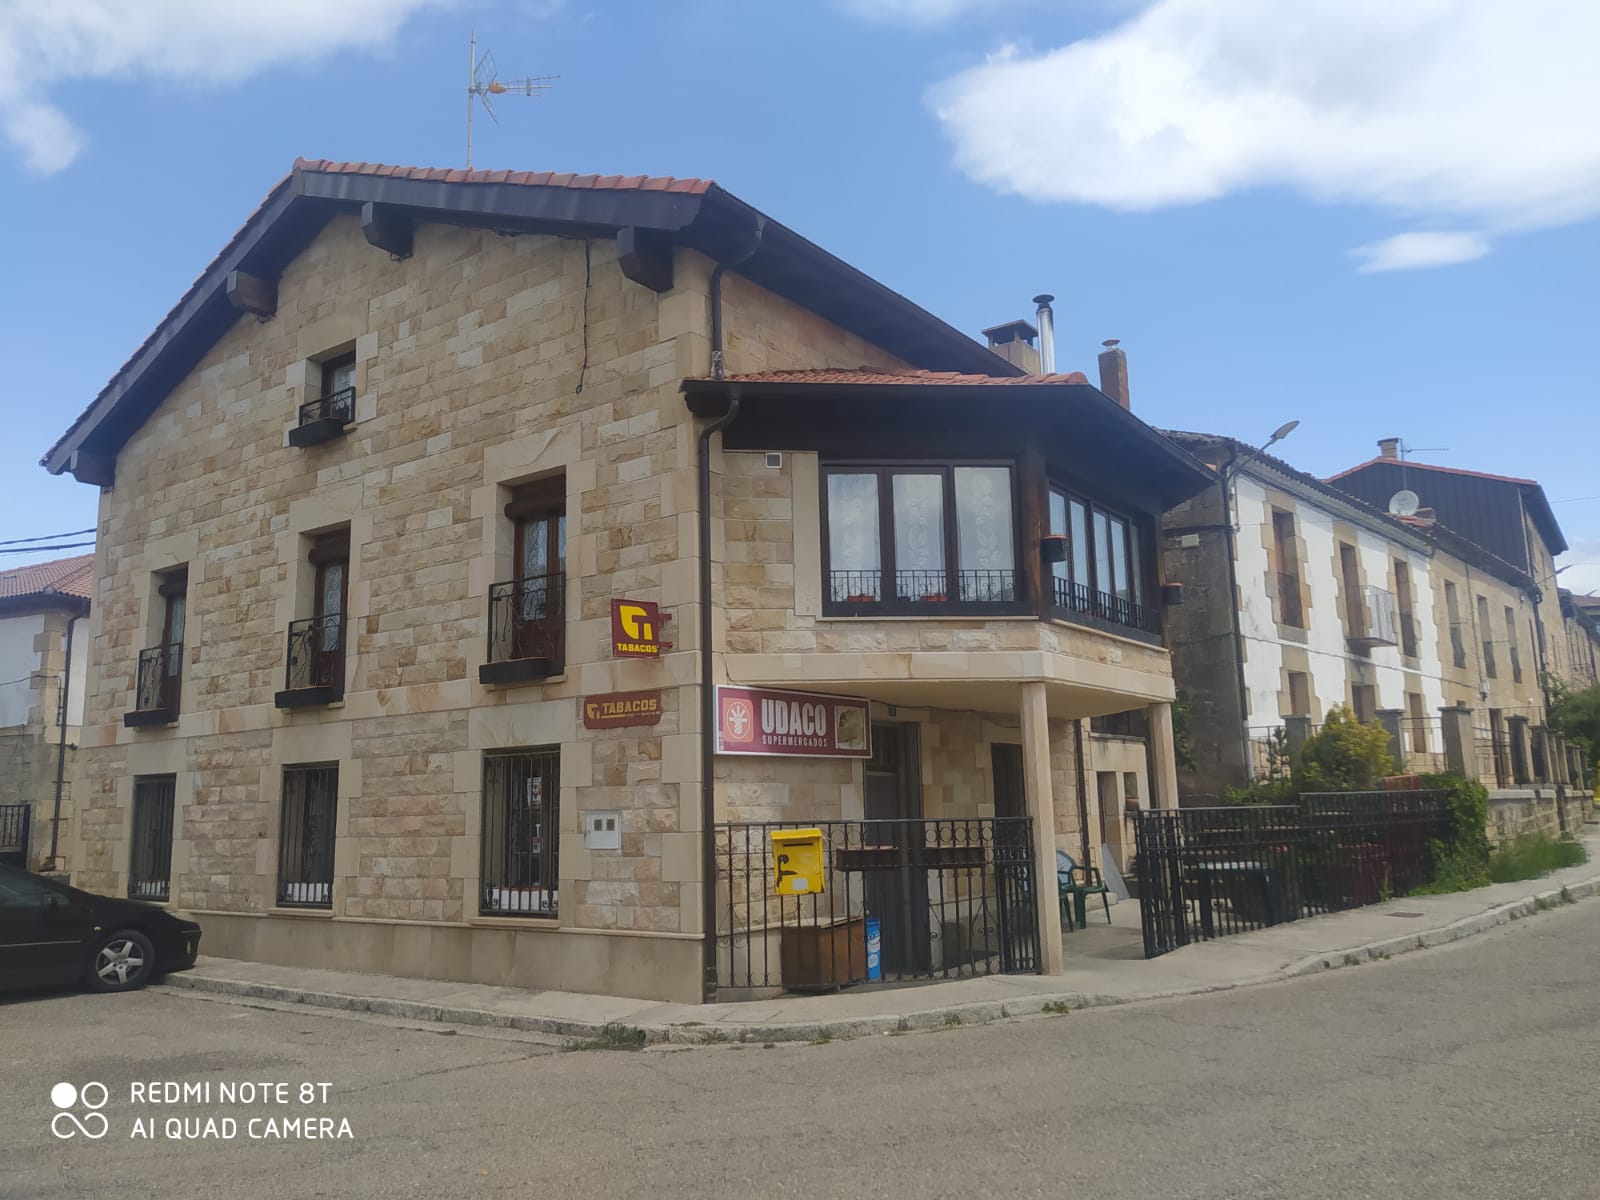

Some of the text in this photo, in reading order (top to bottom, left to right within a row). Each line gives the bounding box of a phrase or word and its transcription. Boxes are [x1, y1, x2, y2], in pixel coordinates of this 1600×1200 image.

[617, 643, 658, 653] TABACOS
[602, 699, 657, 714] TABACOS
[761, 699, 827, 736] UDACO
[762, 735, 828, 747] SUPERMERCADOS
